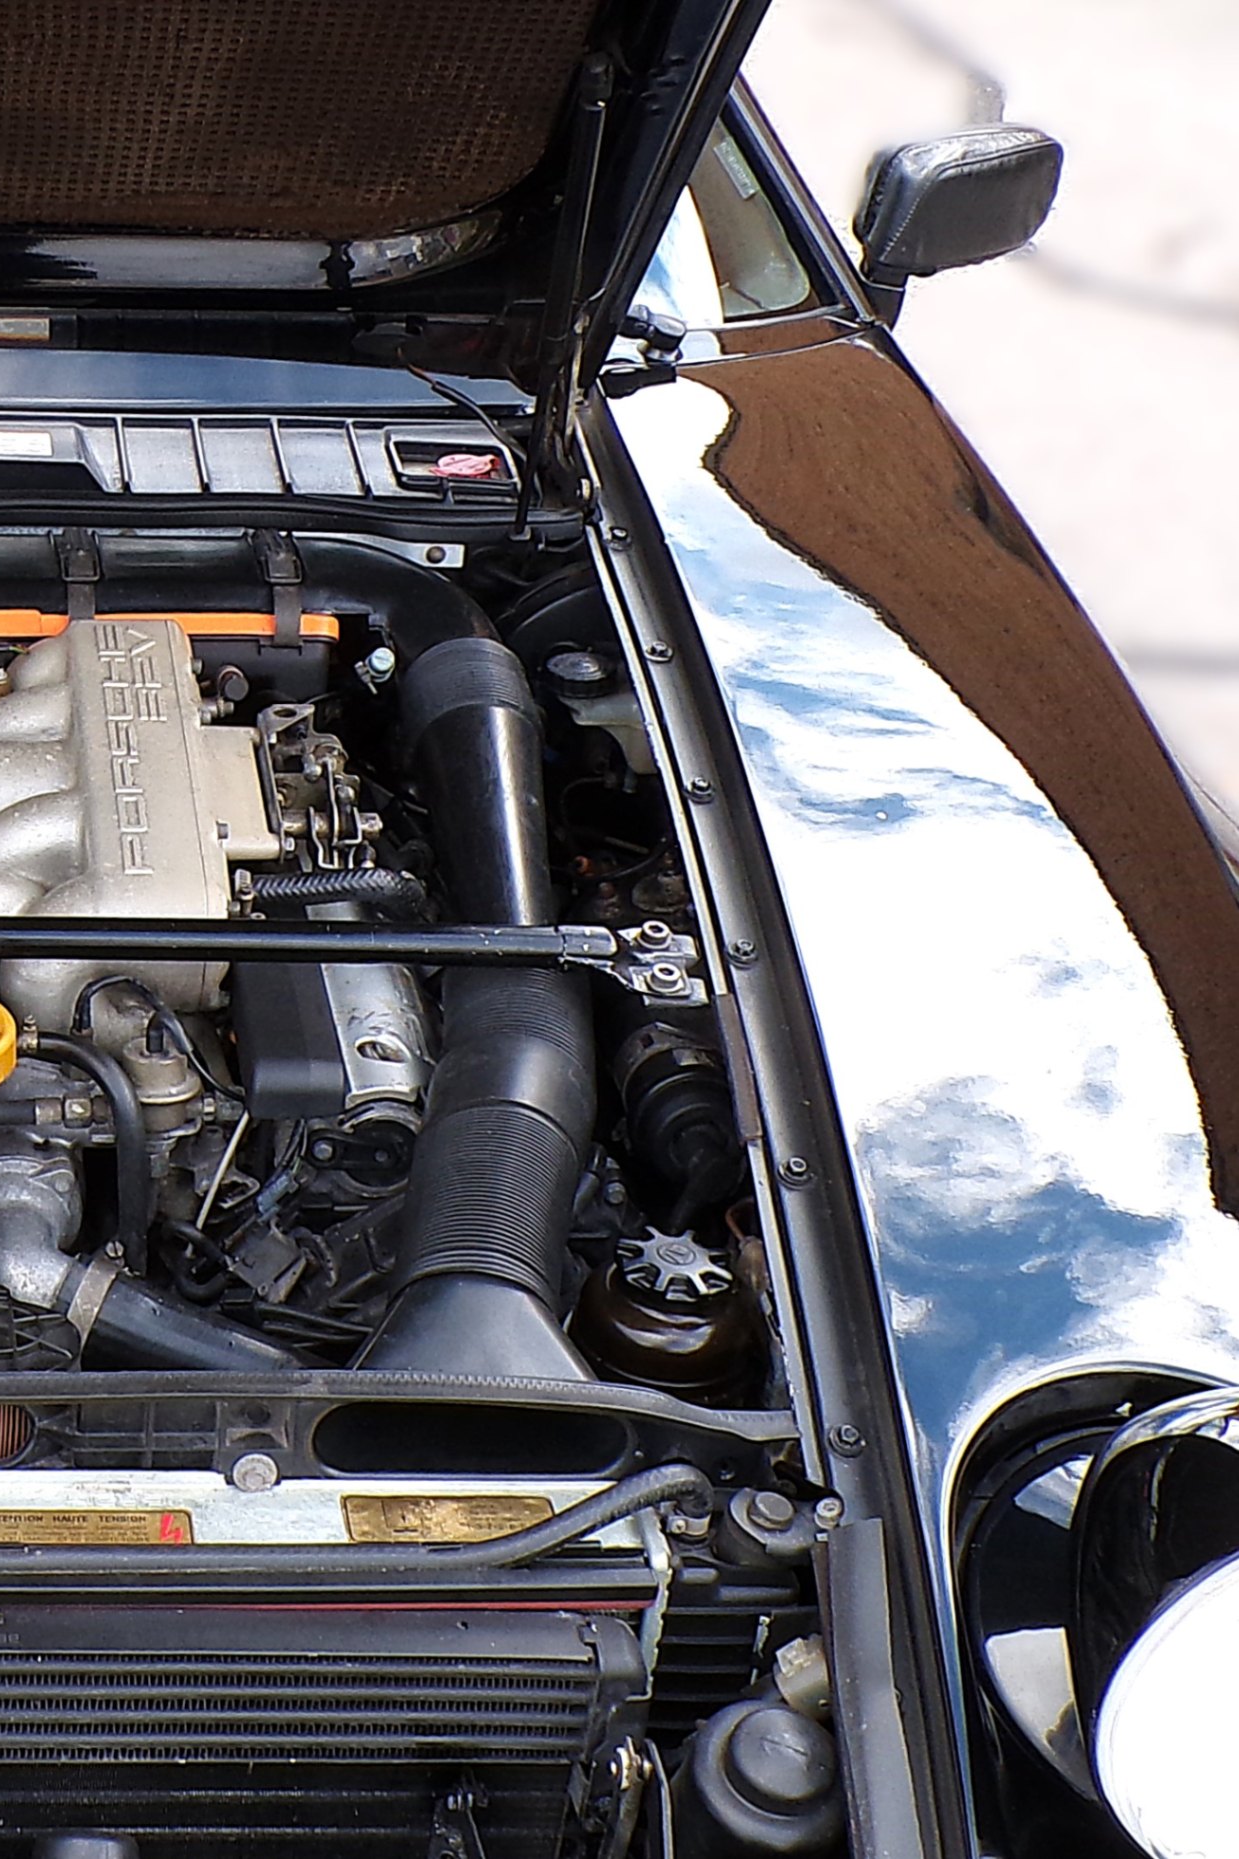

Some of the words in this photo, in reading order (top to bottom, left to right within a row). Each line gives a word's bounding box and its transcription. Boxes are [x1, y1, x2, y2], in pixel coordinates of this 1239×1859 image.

[95, 624, 154, 876] PORSCHE
[52, 1514, 89, 1523] HAUTE
[99, 1514, 147, 1523] TENSION
